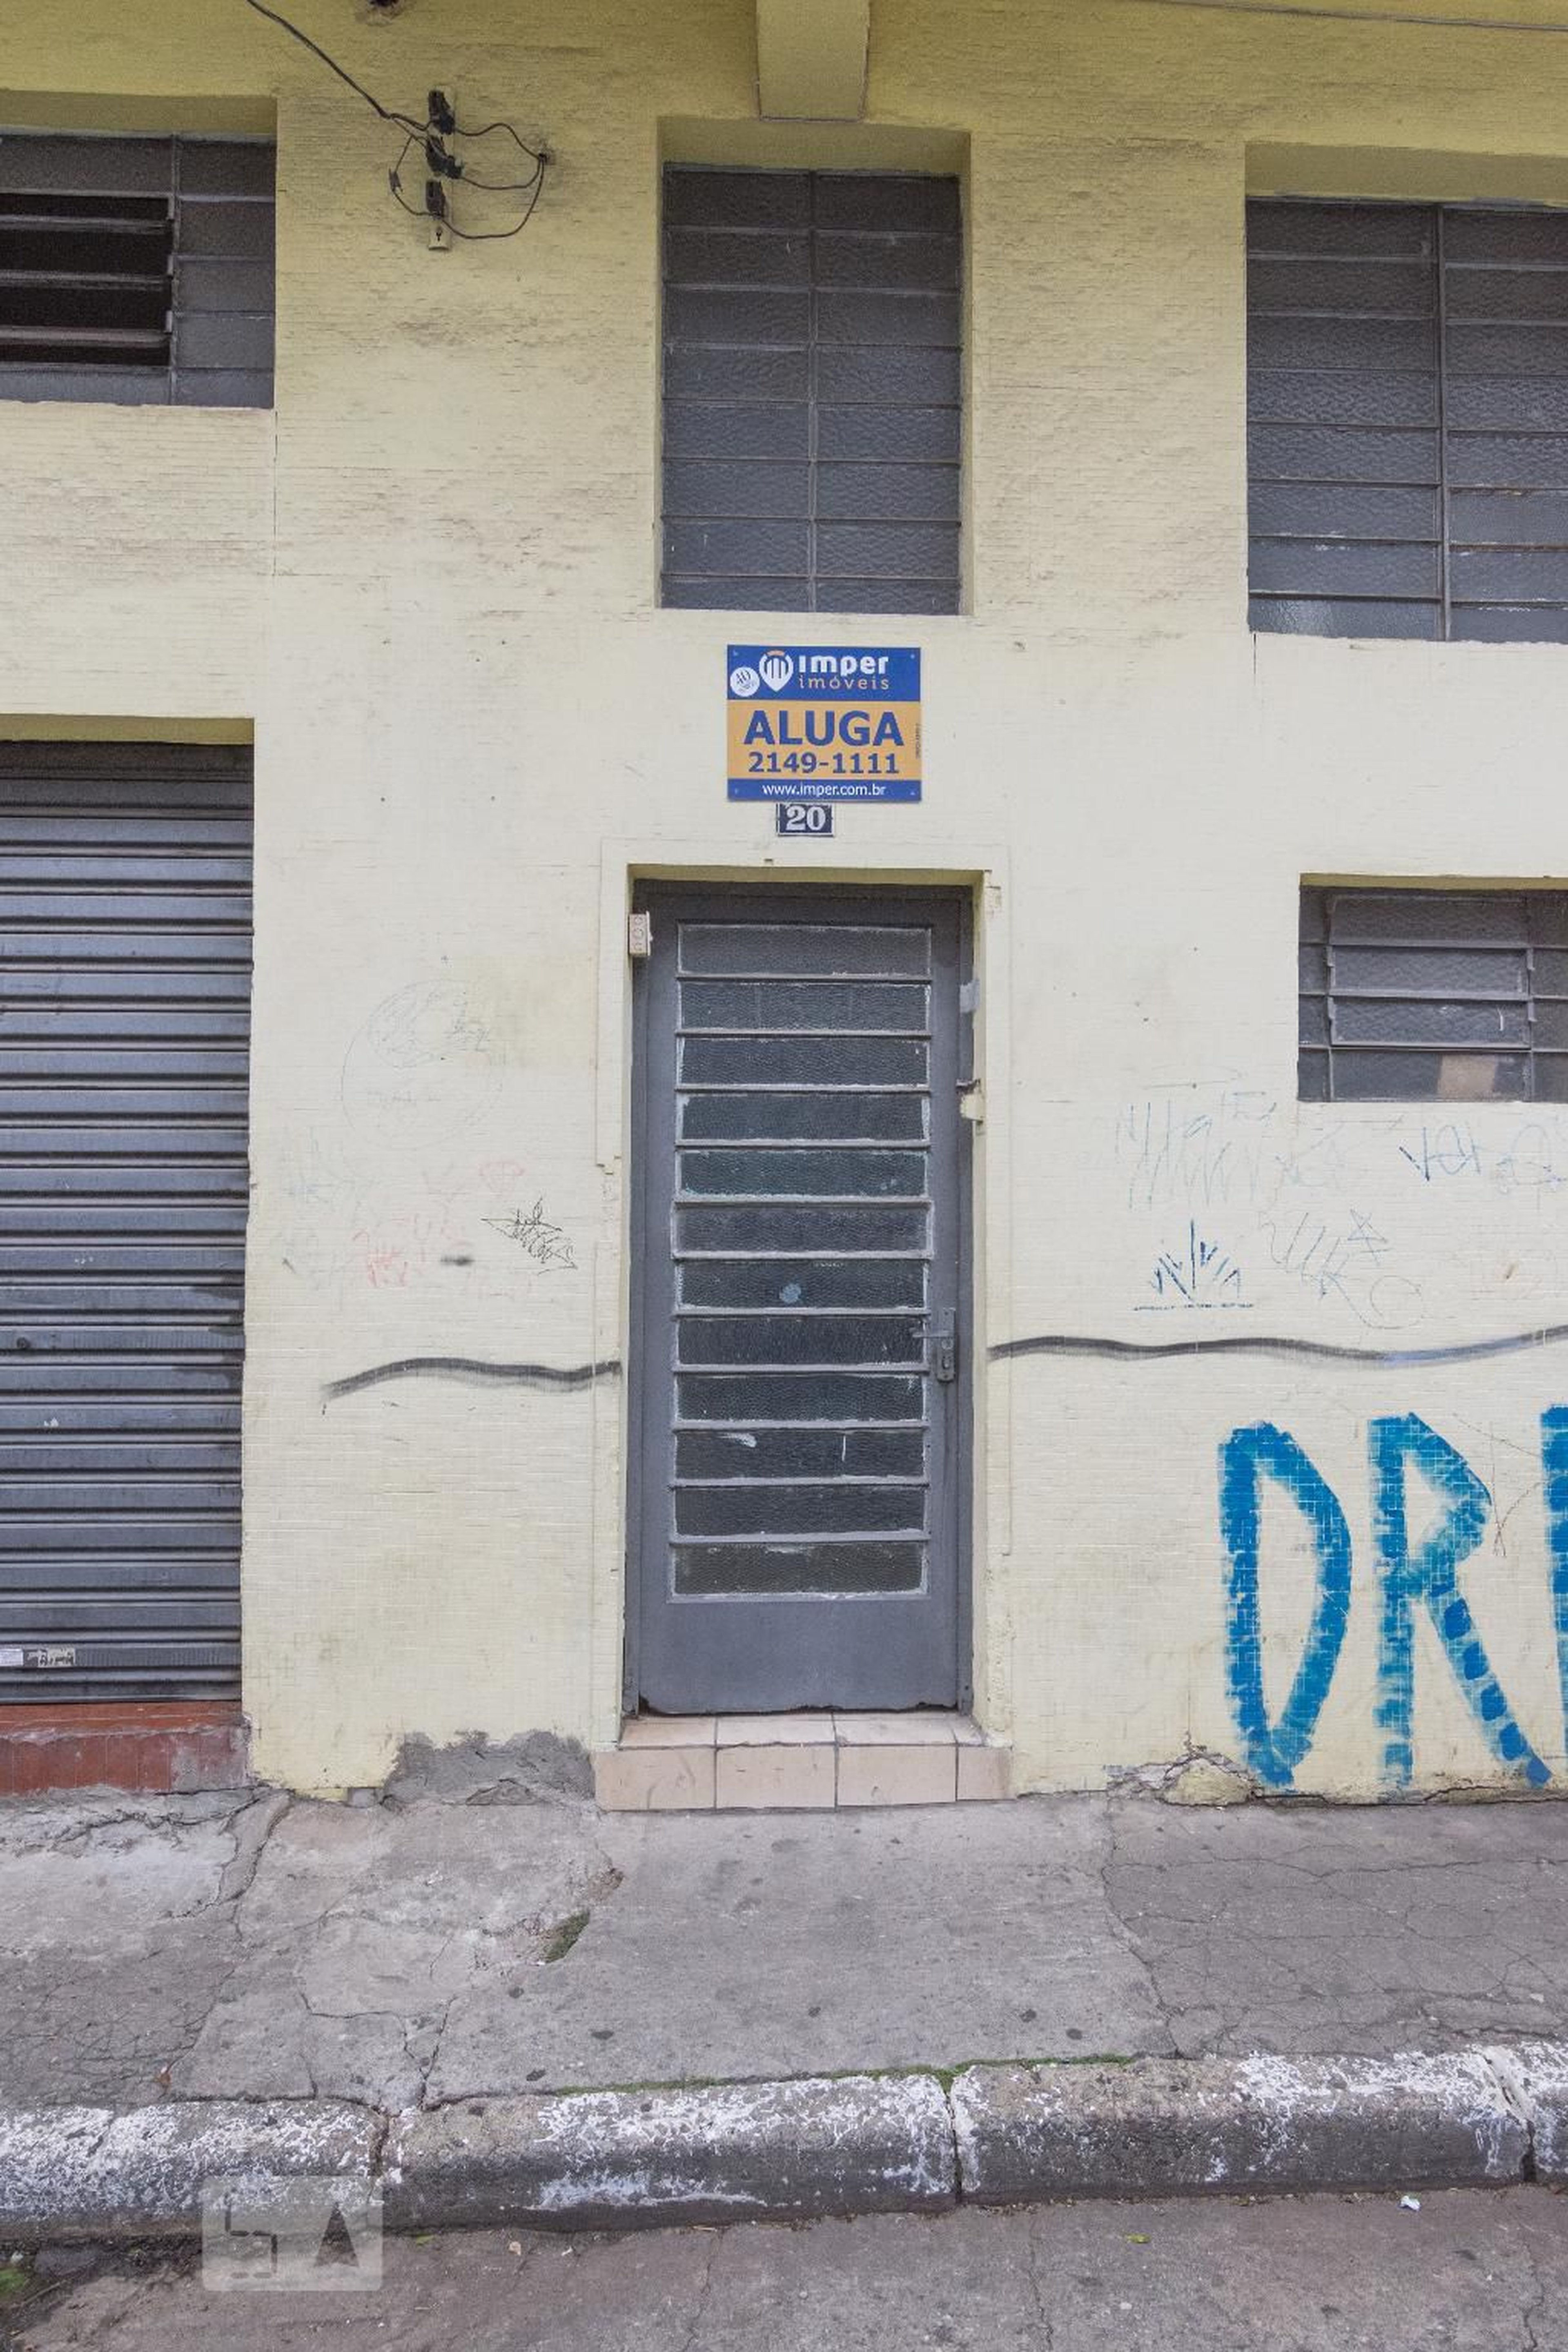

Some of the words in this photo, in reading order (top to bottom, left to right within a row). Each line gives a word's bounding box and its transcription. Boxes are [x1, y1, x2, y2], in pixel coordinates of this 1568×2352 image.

[799, 655, 889, 676] imper
[799, 675, 889, 690] imóveis
[744, 710, 904, 746] ALUGA
[748, 751, 899, 774] 2149-1111
[762, 784, 886, 797] www.imper.com.br
[785, 805, 826, 831] 20
